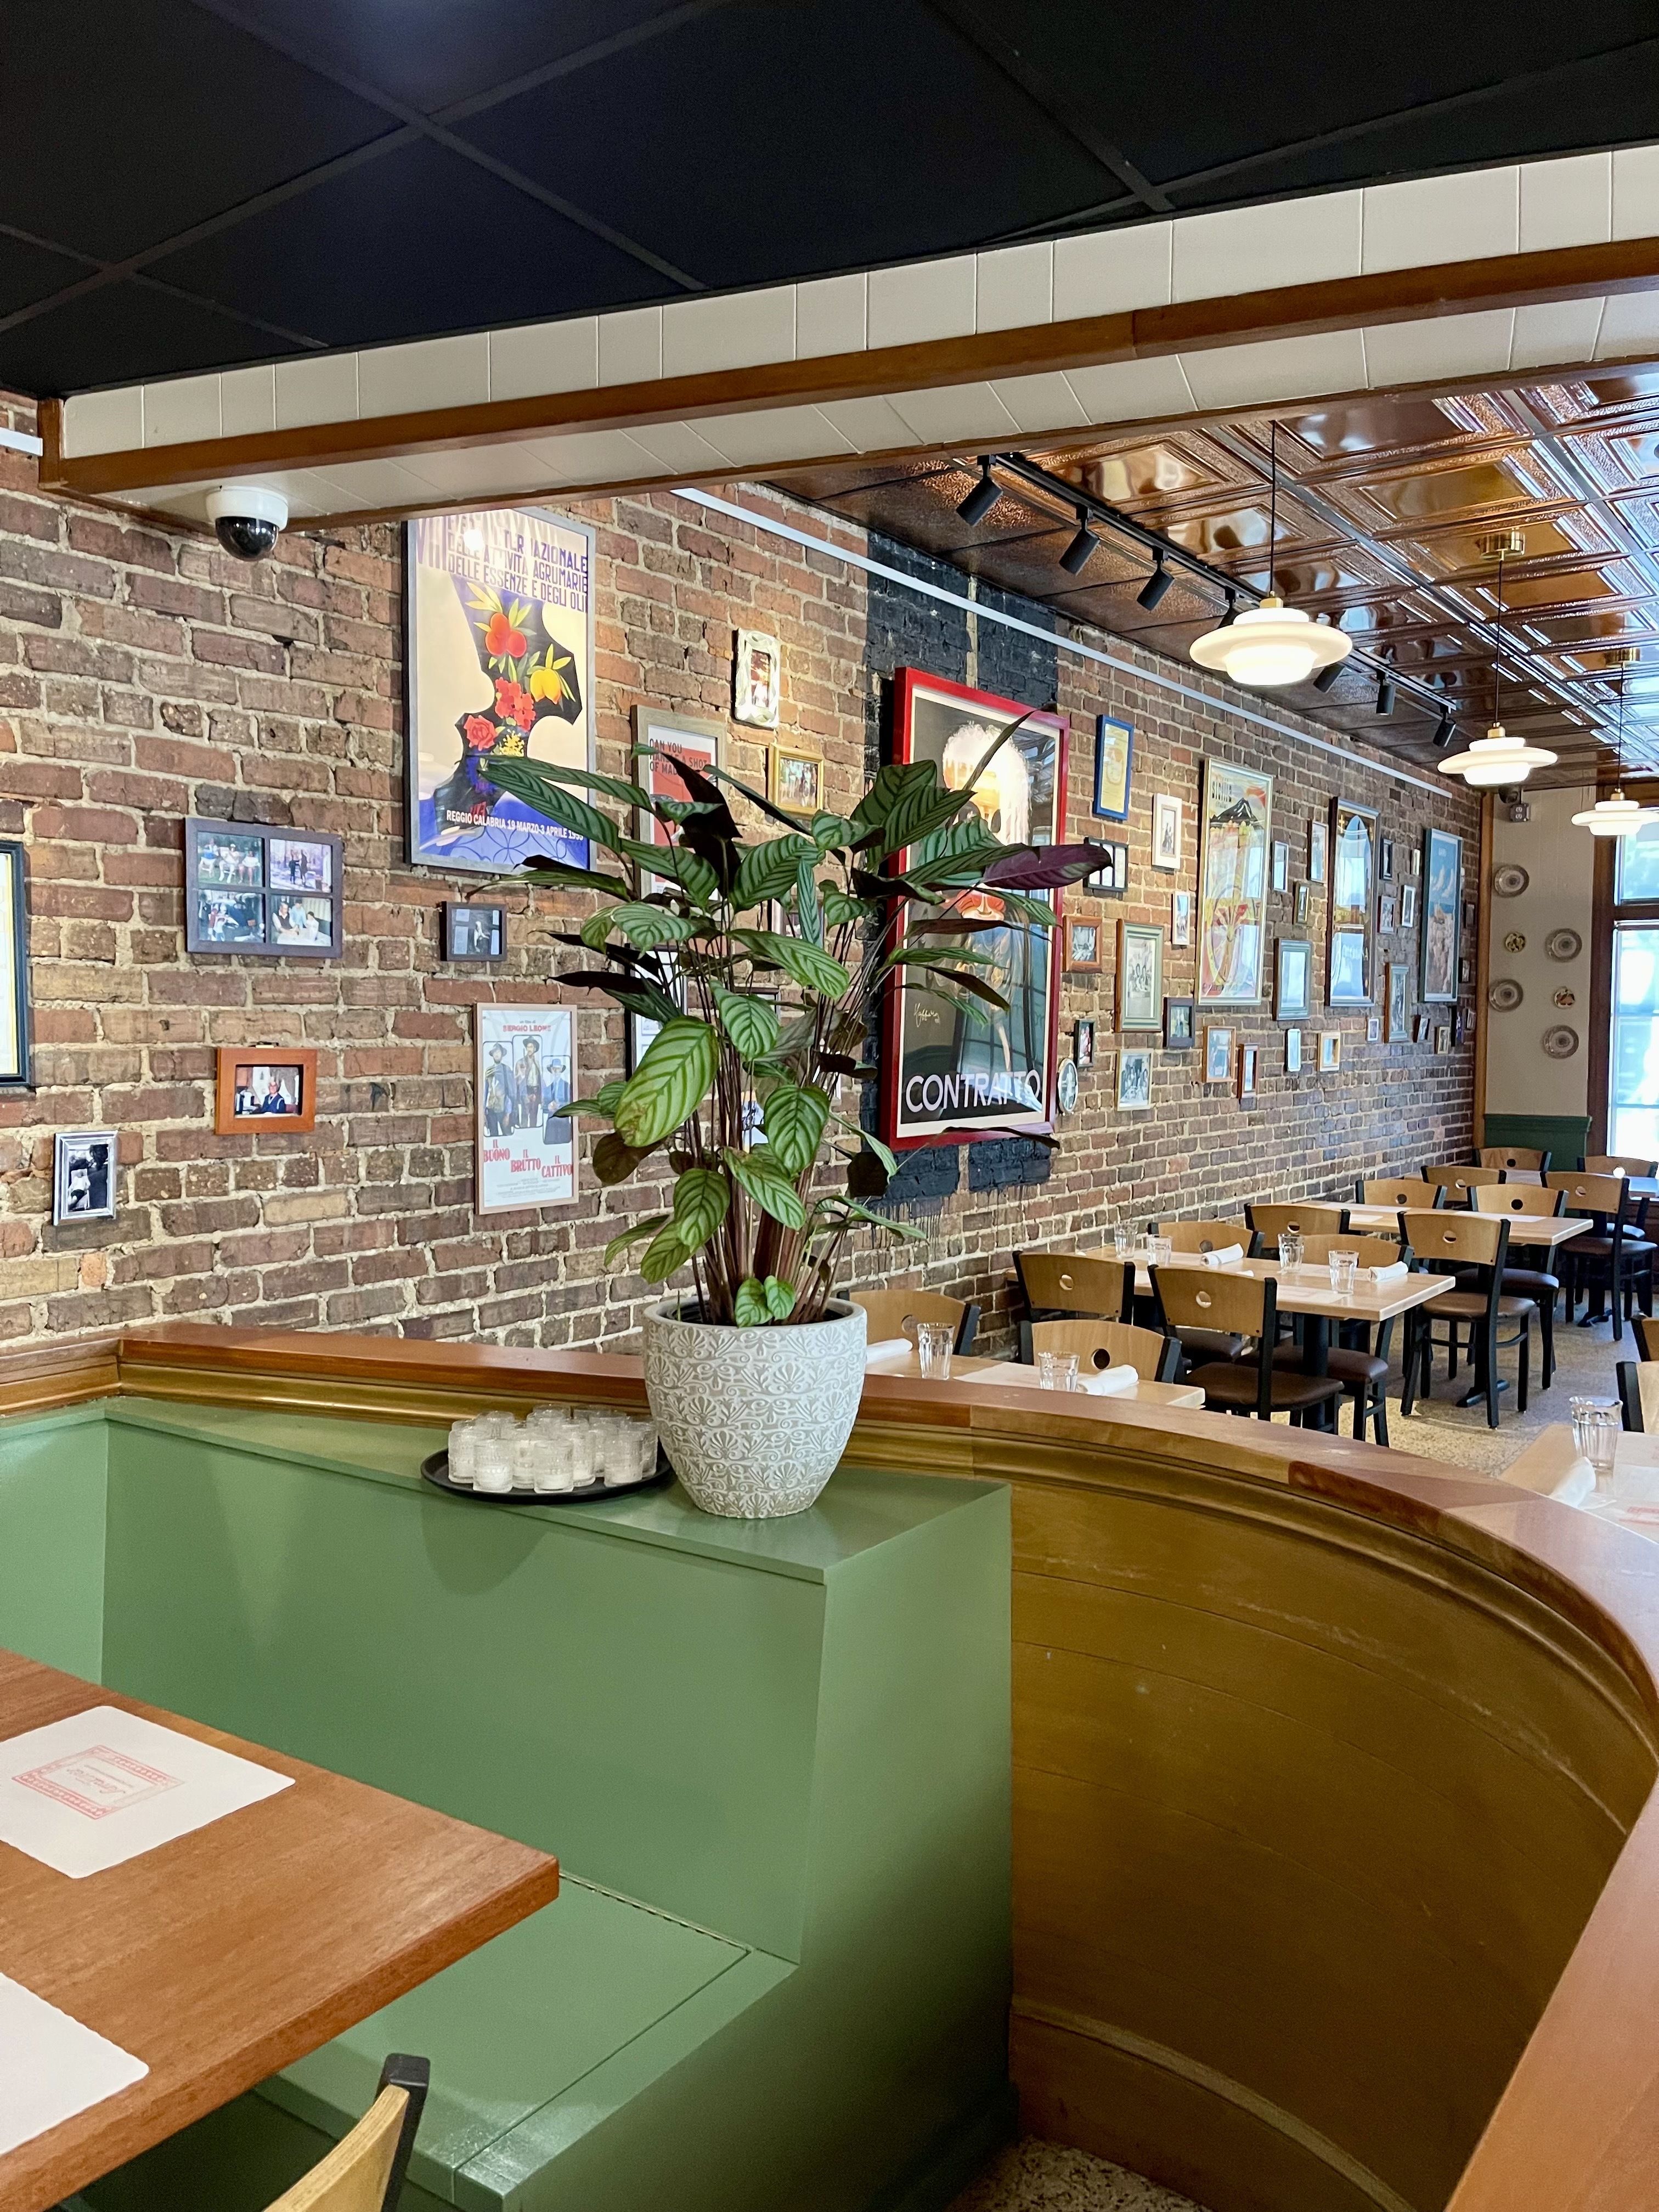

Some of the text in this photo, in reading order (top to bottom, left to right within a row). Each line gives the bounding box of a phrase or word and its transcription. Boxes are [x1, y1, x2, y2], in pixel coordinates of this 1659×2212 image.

[448, 532, 480, 561] DELE
[448, 554, 480, 581] DELLE
[483, 565, 528, 596] ESSENZE
[532, 580, 537, 598] E
[541, 583, 566, 607] DEGLI
[650, 738, 682, 754] CAN YOU
[650, 761, 659, 772] OF
[446, 809, 472, 825] REGGIO
[473, 813, 506, 830] CALABRIA
[507, 820, 516, 831] 19
[545, 825, 567, 839] APRILE
[905, 1069, 1041, 1113] CONTRATTO
[493, 1139, 499, 1148] IL
[483, 1148, 511, 1163] BUONO
[523, 1149, 529, 1159] IL
[555, 1155, 561, 1164] IL
[510, 1158, 541, 1173] BRUTTO
[541, 1164, 574, 1178] CATTIVO
